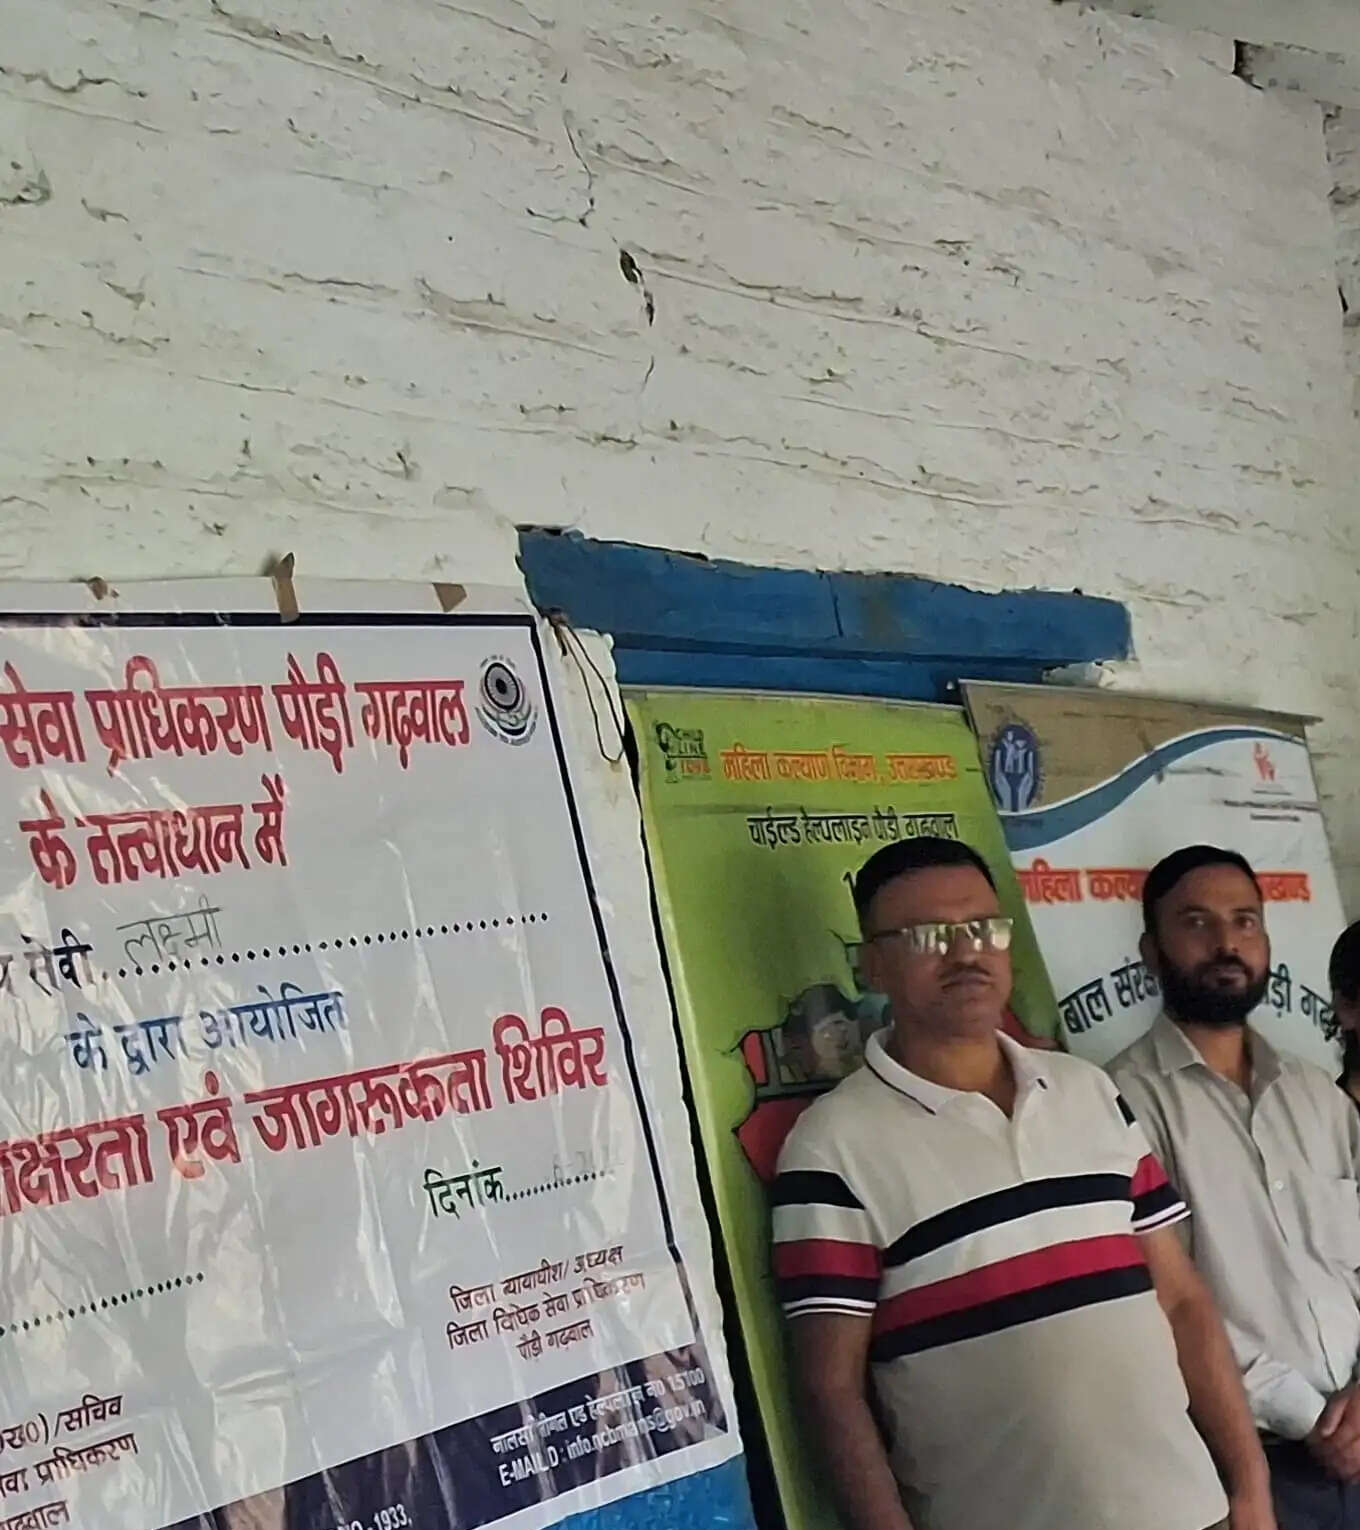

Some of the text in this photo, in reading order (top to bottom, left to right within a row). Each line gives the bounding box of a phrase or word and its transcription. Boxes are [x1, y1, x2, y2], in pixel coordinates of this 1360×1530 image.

[0, 652, 470, 776] सेवा प्राधिकरण पौड़ी गढ़वाल
[720, 742, 771, 780] महिला
[19, 788, 76, 890] के
[252, 773, 287, 867] में
[65, 982, 345, 1076] के द्वारा आयोजित
[1058, 978, 1113, 1034] बाल
[0, 1114, 154, 1216] ाक्षरता
[157, 1071, 241, 1180] एवं
[493, 1006, 609, 1105] शिविर
[449, 1284, 496, 1313] जिला
[573, 1245, 624, 1275] अध्यक्ष
[446, 1318, 489, 1350] जिला
[542, 1291, 570, 1320] सेवा
[33, 1432, 139, 1486] प्राधिकरण
